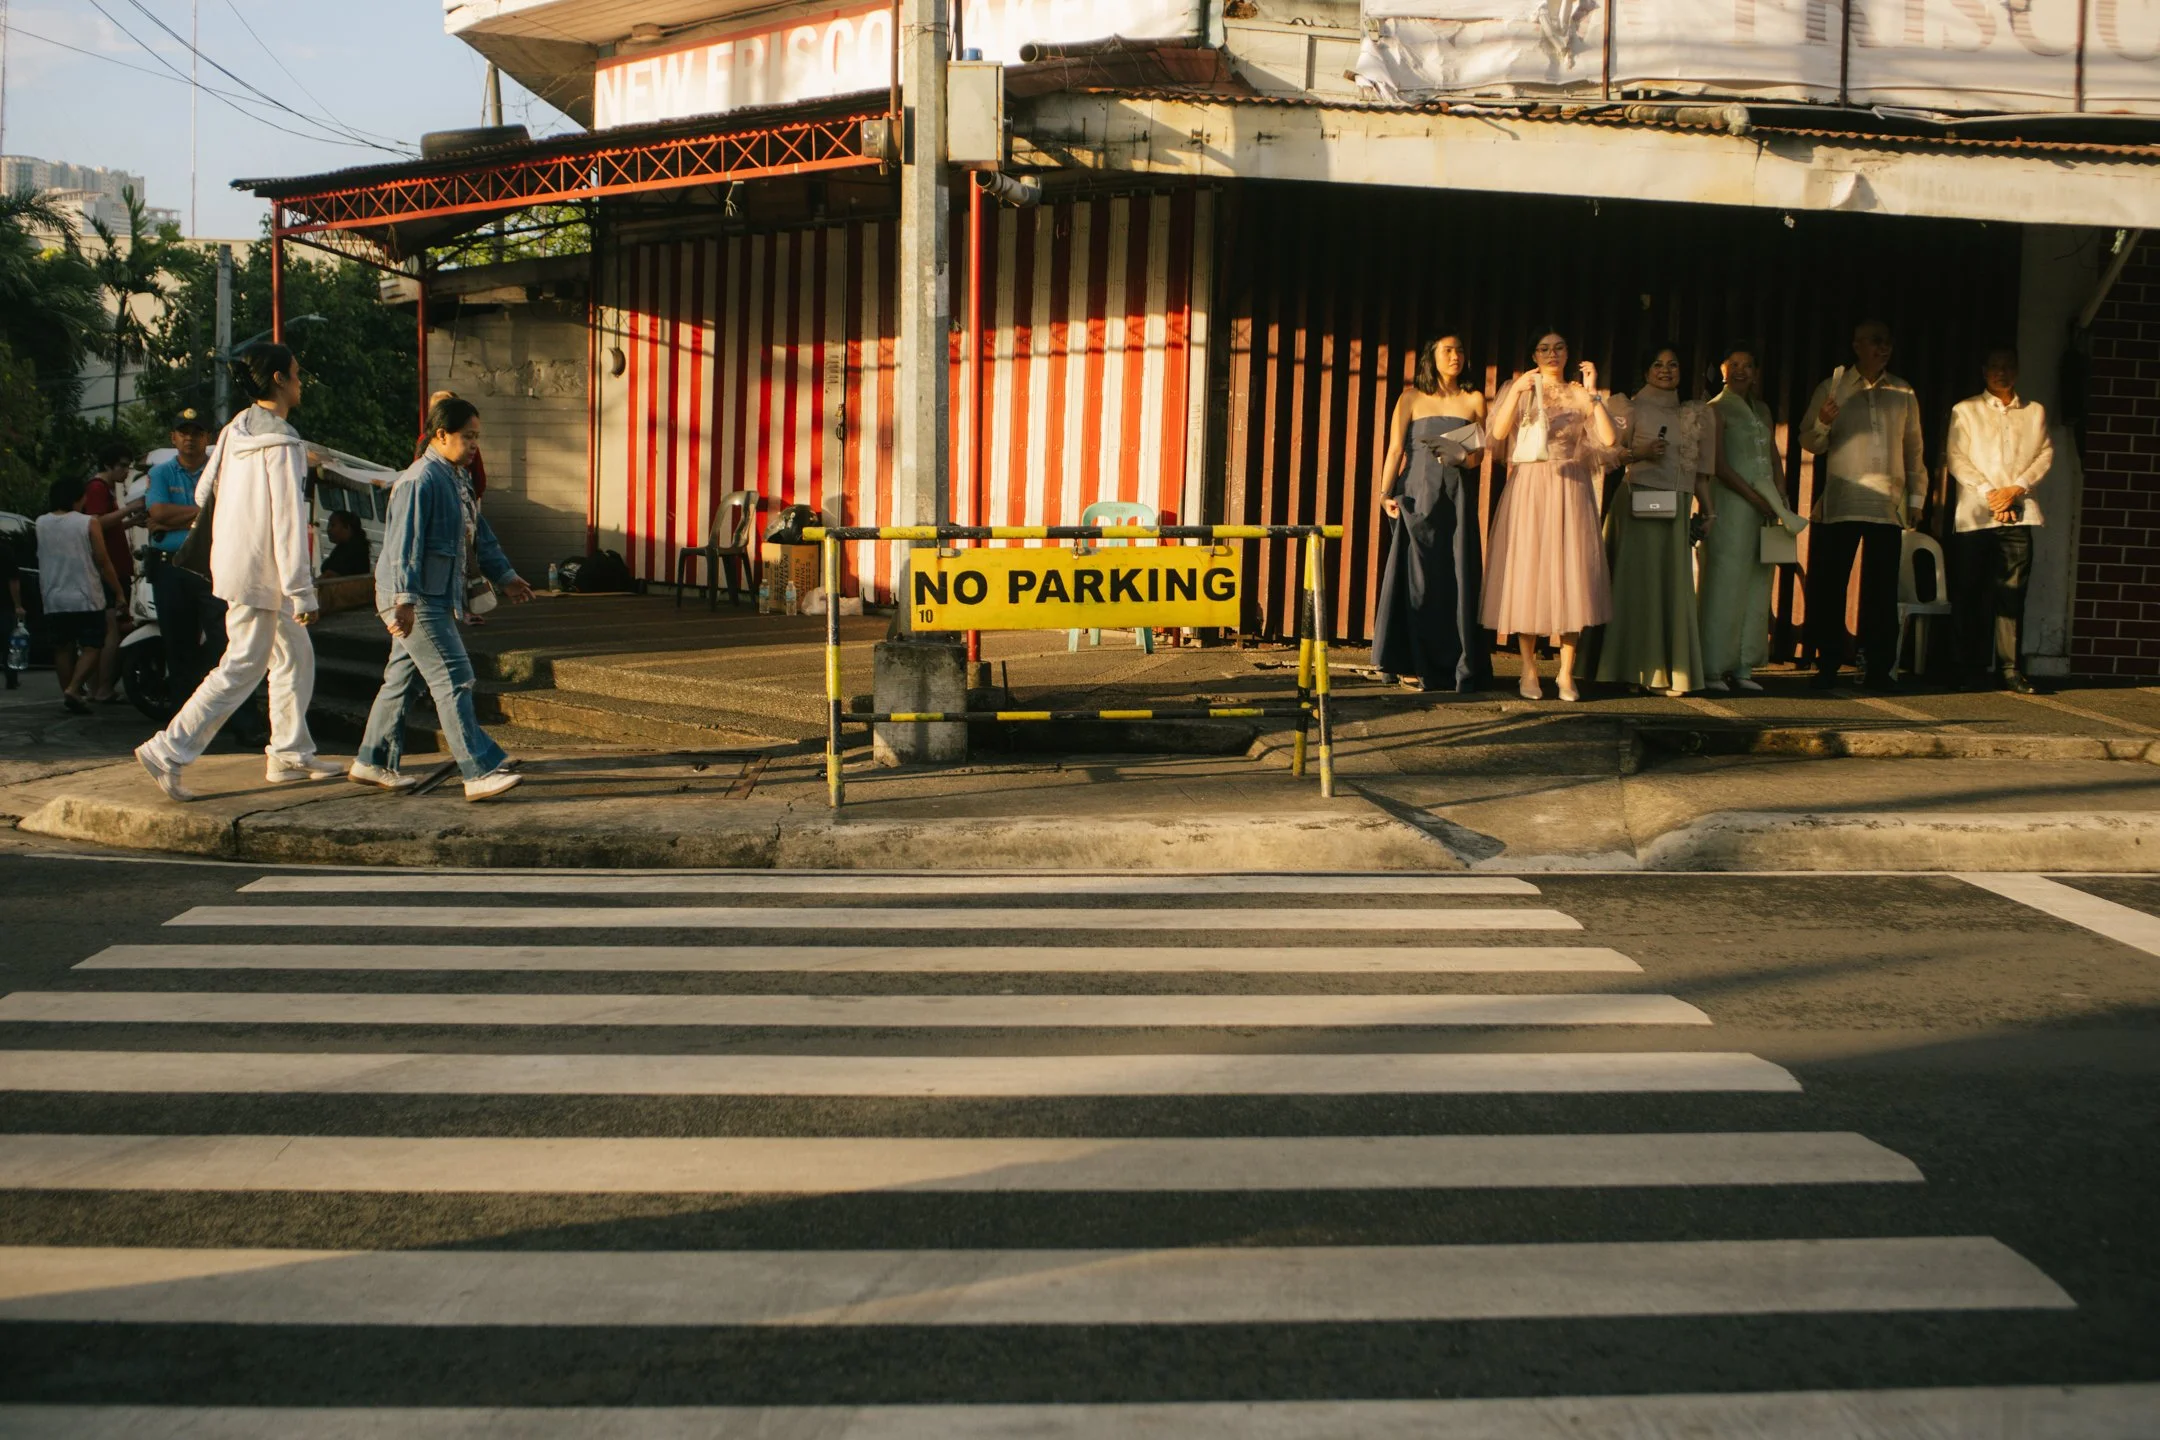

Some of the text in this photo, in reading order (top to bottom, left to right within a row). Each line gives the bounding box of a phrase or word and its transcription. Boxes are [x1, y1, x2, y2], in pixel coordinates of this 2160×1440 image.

[595, 50, 694, 129] NEW
[704, 9, 893, 112] FRISCO
[914, 567, 1236, 606] NO PARKING
[919, 609, 934, 624] 10
